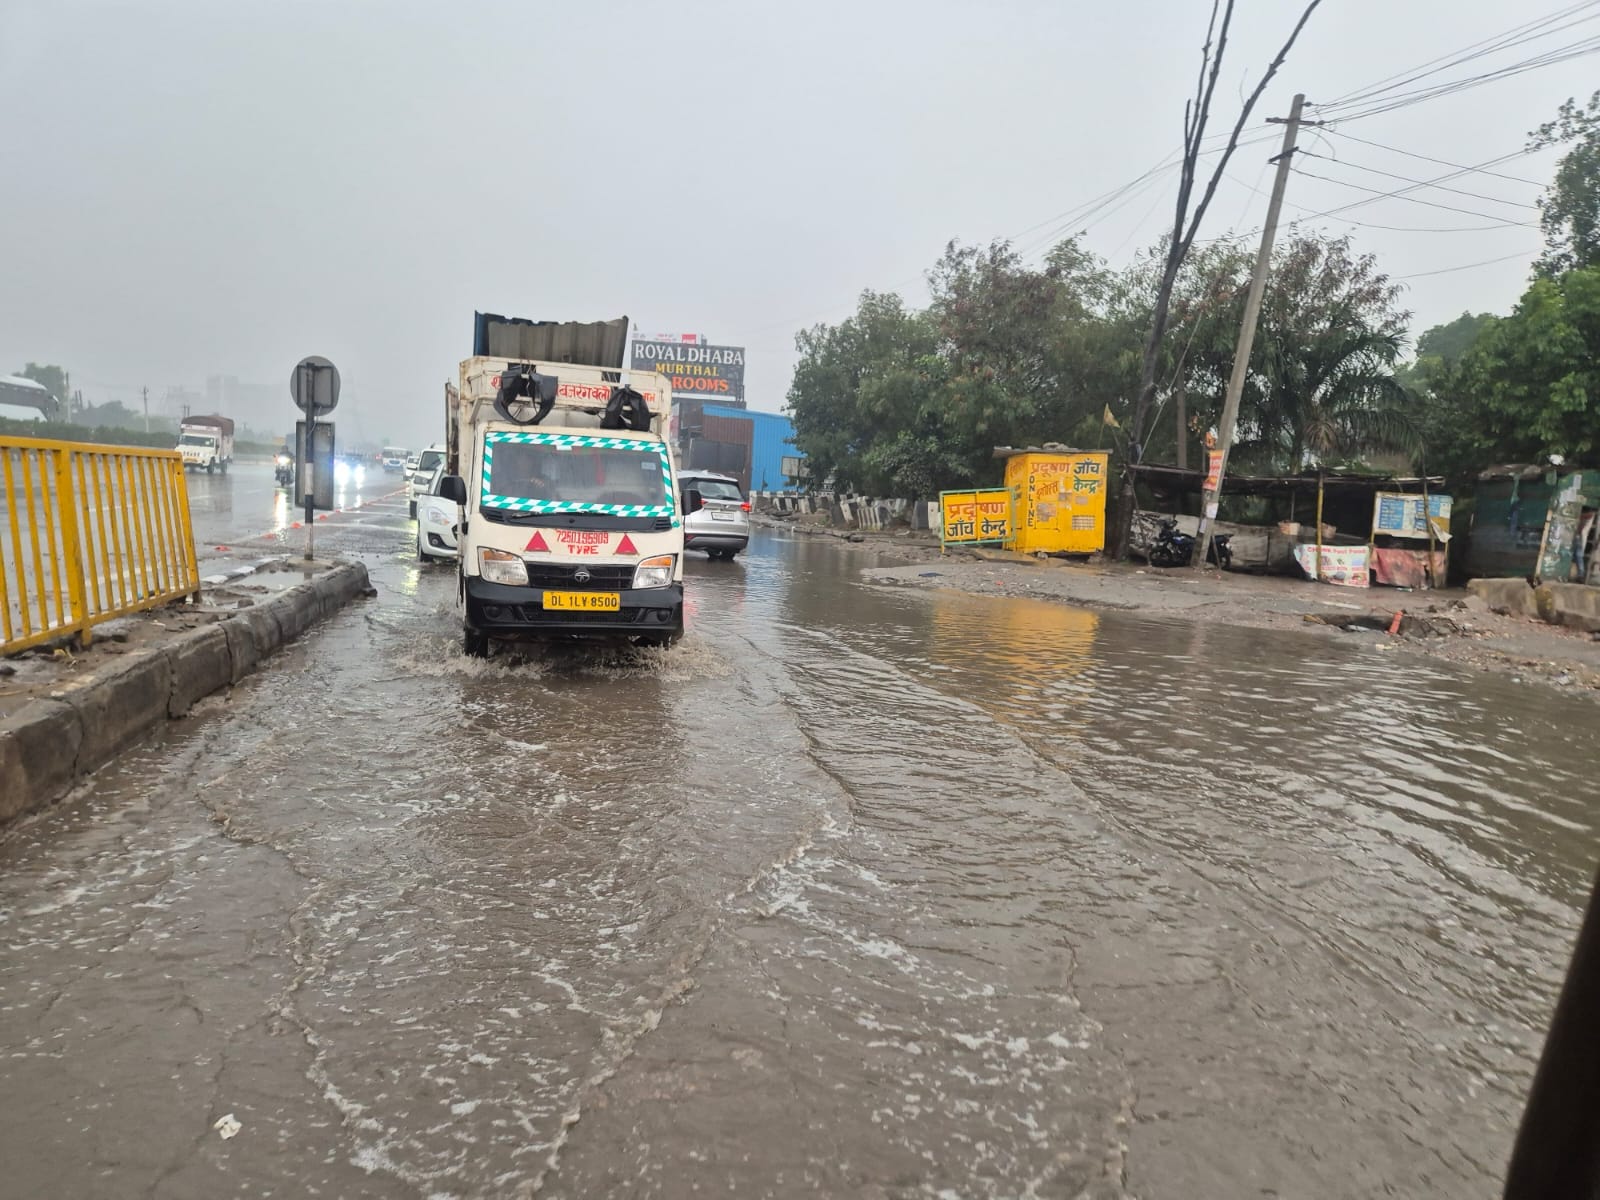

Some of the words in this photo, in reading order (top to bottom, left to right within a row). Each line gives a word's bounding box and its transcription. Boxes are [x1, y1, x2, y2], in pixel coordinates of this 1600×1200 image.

[635, 343, 686, 361] ROYAL
[687, 347, 744, 366] DHABA
[655, 362, 720, 377] MURTHAL
[671, 375, 729, 392] ROOMS
[1027, 475, 1036, 527] ONLINE
[551, 595, 564, 606] DL
[569, 596, 588, 607] 1LV
[590, 597, 617, 608] 8500
